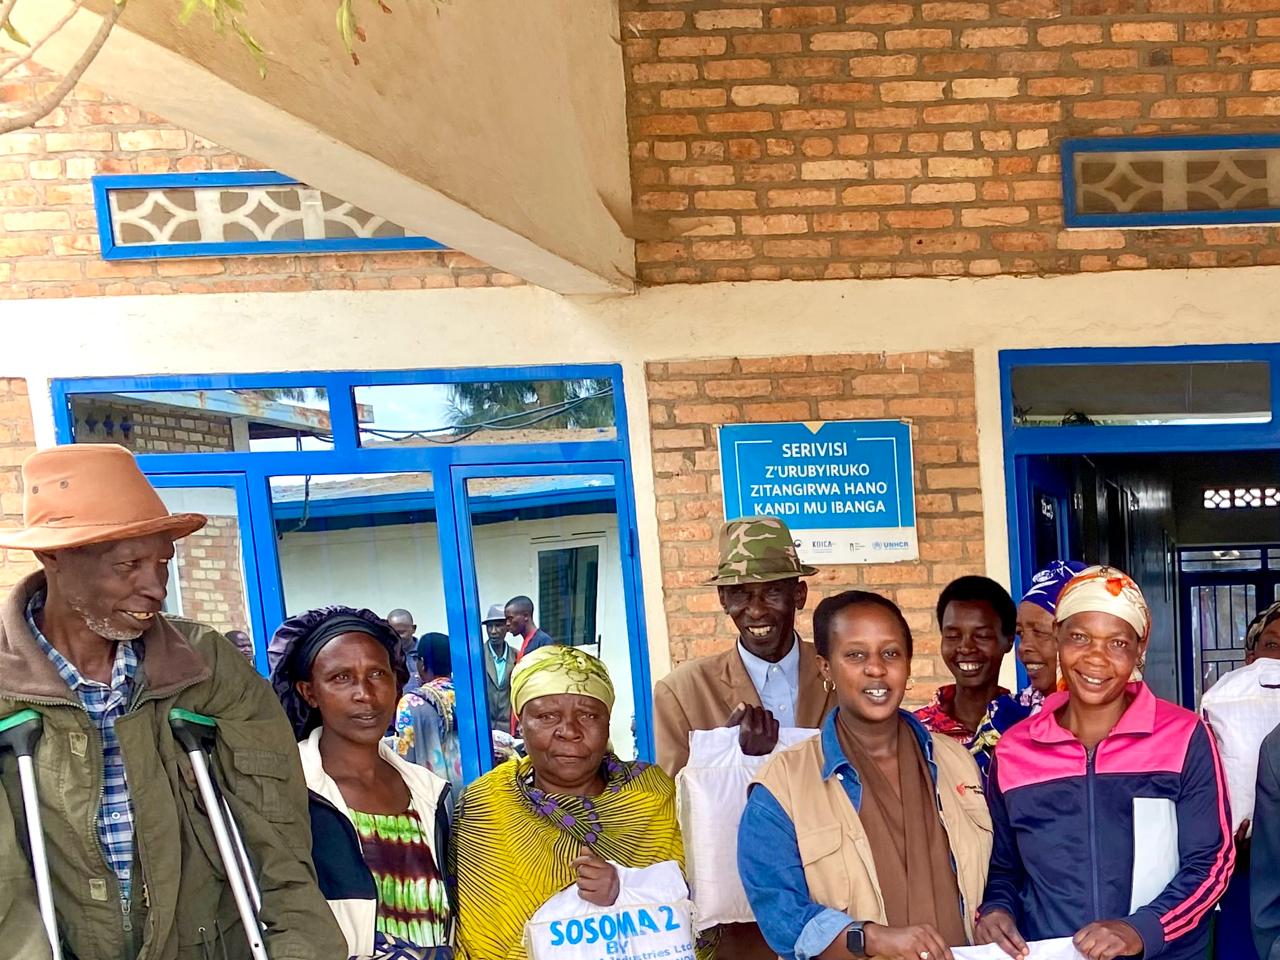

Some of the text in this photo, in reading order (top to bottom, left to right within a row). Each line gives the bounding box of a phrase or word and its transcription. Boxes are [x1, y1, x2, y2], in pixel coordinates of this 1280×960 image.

[782, 442, 847, 458] SERIVISI
[765, 463, 870, 479] Z'URUBYIRUKO
[750, 481, 888, 498] ZITANGIRWA HANO
[754, 500, 886, 516] KANDI MU IBANGA
[550, 905, 681, 946] SOSOMA 2
[606, 940, 629, 955] BY
[674, 941, 693, 954] Ltd
